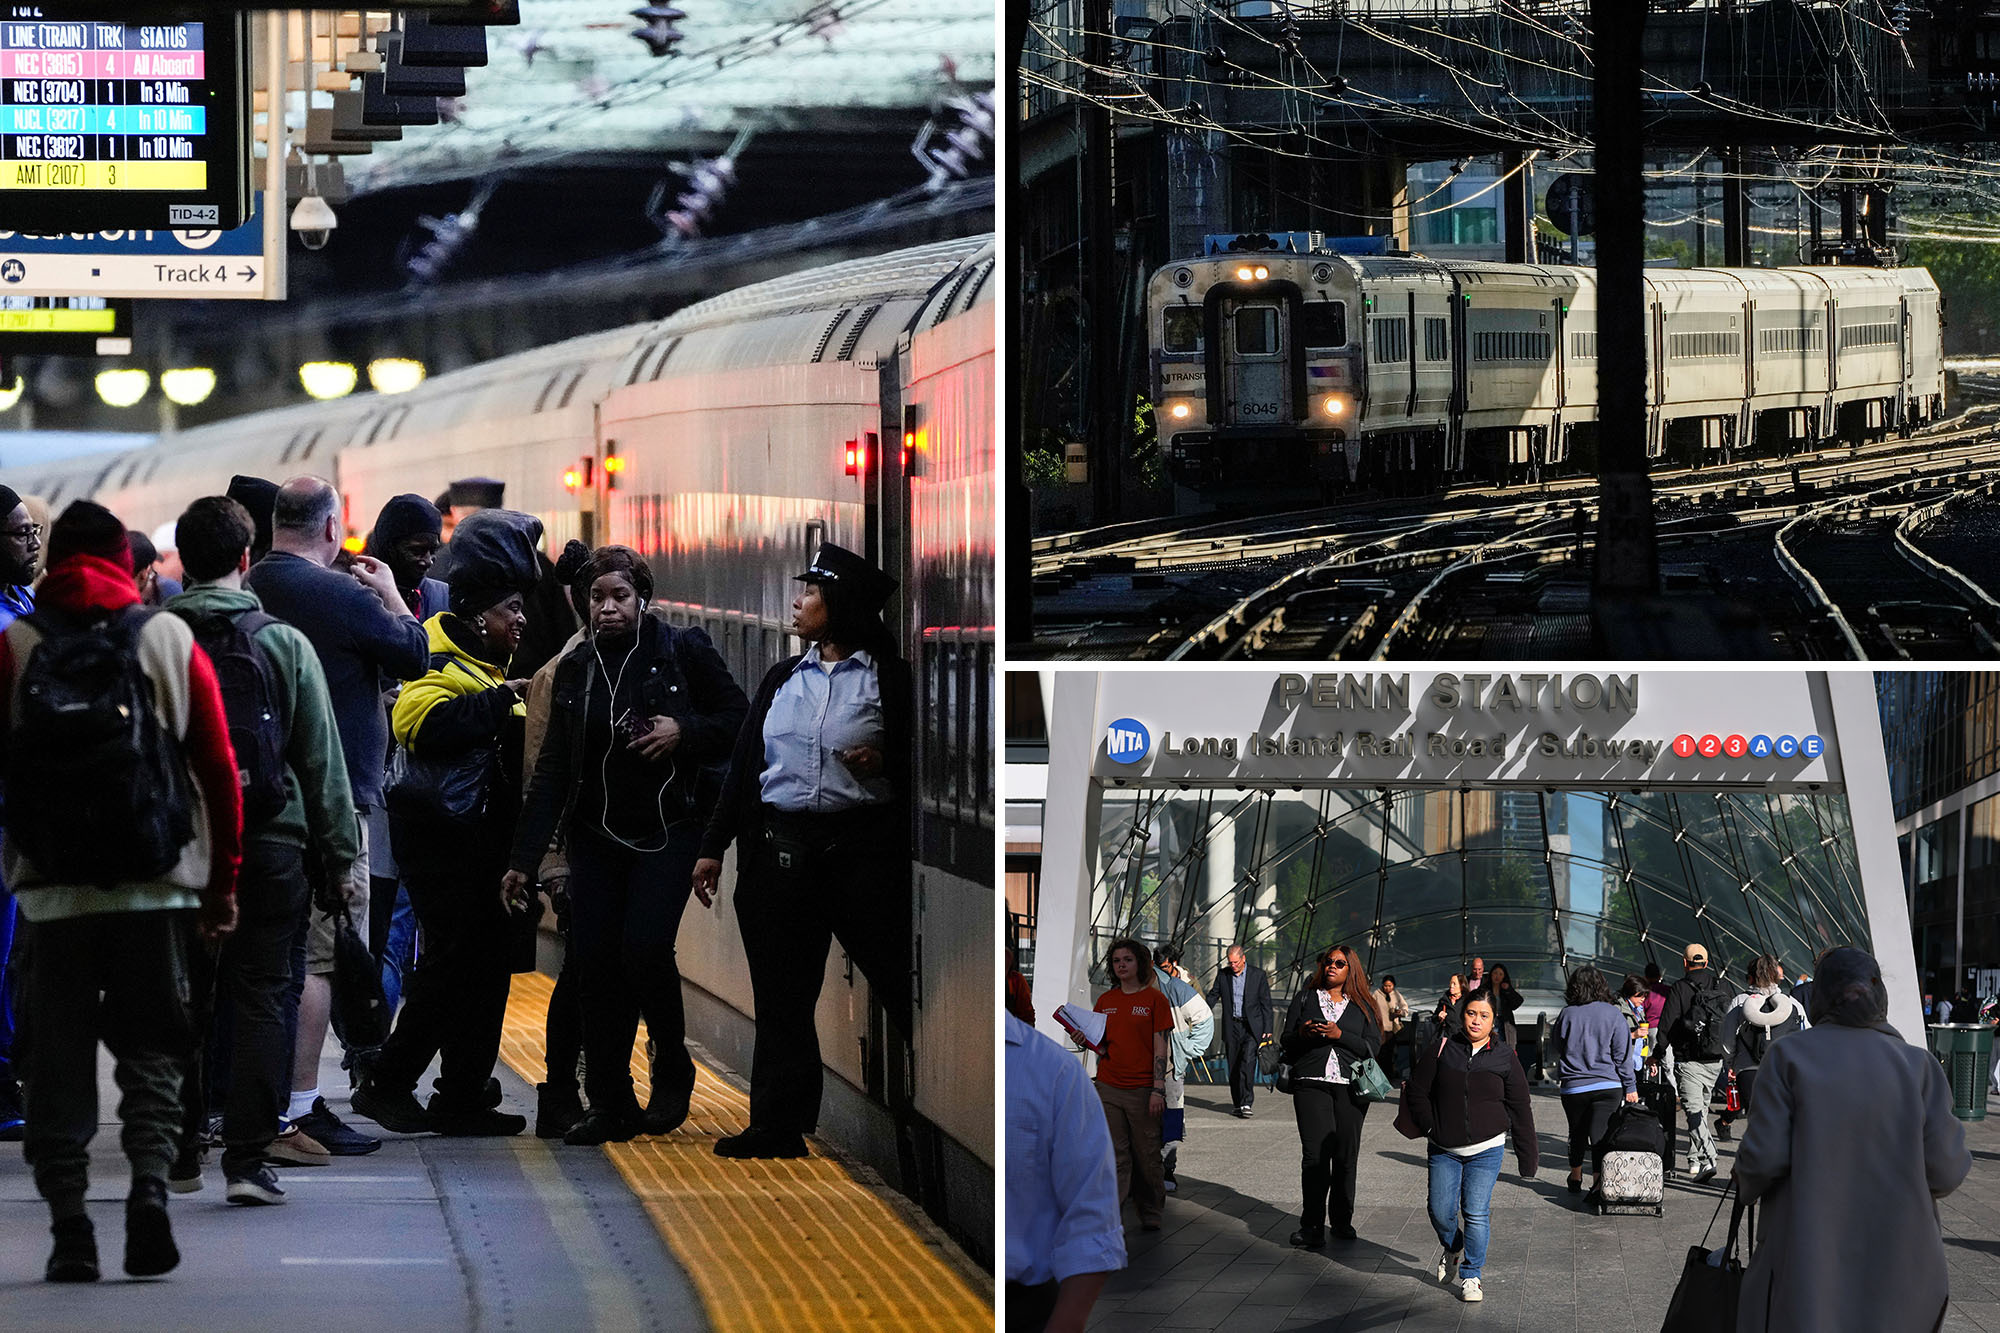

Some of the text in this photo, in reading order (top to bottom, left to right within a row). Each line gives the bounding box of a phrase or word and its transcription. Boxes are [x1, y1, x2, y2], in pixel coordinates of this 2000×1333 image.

[8, 25, 36, 48] LINE
[97, 26, 122, 48] TRK
[140, 26, 187, 49] STATUS
[15, 53, 39, 75] NEC
[105, 54, 115, 75] 4
[133, 55, 149, 75] All
[152, 55, 195, 76] Aboard
[13, 80, 38, 103] NEC
[107, 82, 114, 103] 1
[140, 82, 153, 103] In
[155, 82, 164, 103] 3
[165, 82, 189, 103] Min
[14, 108, 43, 130] NJCL
[107, 110, 116, 130] 4
[139, 110, 151, 130] In
[154, 110, 167, 130] 10
[169, 110, 192, 130] Min
[16, 136, 41, 158] NEC
[109, 137, 115, 158] 1
[139, 137, 151, 158] In
[153, 137, 167, 158] 10
[169, 137, 192, 158] Min
[17, 164, 42, 184] AMT
[108, 165, 116, 185] 3
[171, 208, 216, 220] TID-4-2
[154, 264, 227, 282] Track 4
[1243, 403, 1278, 415] 6045
[1279, 672, 1640, 710] PENN STATION
[1107, 728, 1144, 755] MTA
[1165, 731, 1238, 760] Long
[1252, 731, 1344, 758] Island
[1356, 731, 1415, 758] Rail
[1427, 732, 1506, 759] Road
[1540, 732, 1664, 765] Subway
